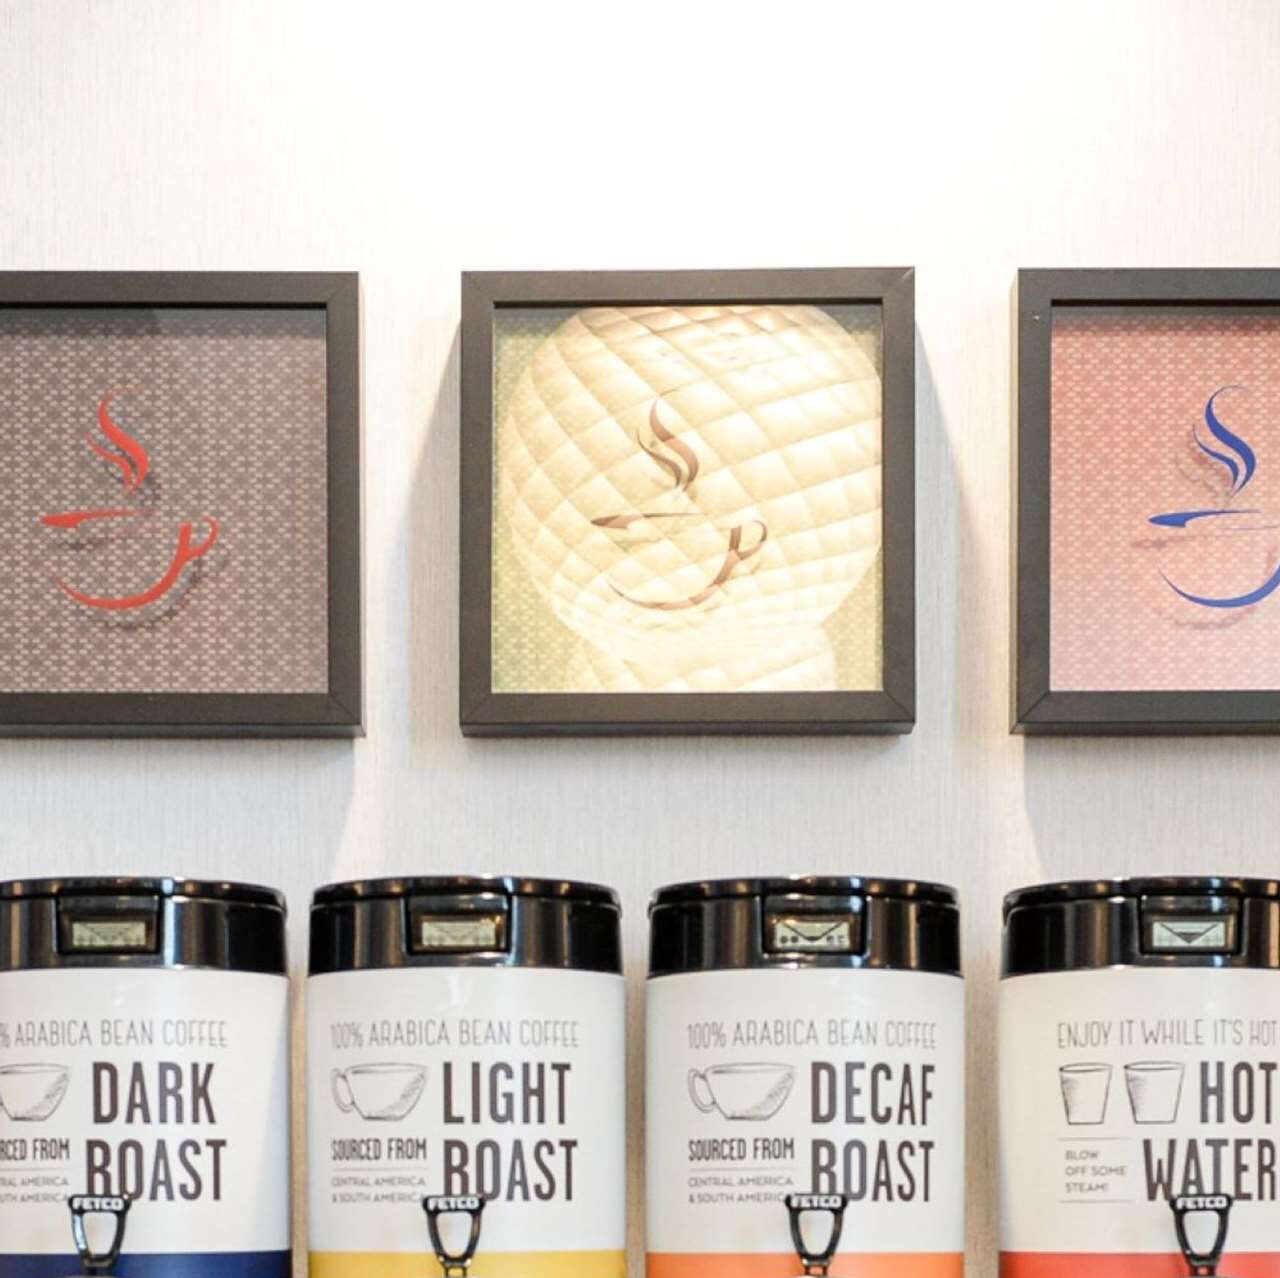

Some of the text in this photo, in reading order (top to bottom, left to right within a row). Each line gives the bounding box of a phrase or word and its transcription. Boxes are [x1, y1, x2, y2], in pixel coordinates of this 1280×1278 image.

[14, 1020, 92, 1047] ARABICA
[100, 1019, 153, 1046] BEAN
[162, 1020, 228, 1047] COFFEE
[331, 1019, 578, 1049] 100% ARABICA BEAN COFFEE
[688, 1019, 936, 1050] 100% ARABICA BEAN COFFEE
[1057, 1019, 1278, 1048] ENJOY IT WHILE IT'S HOT
[92, 1061, 216, 1124] DARK
[443, 1061, 571, 1124] LIGHT
[811, 1061, 935, 1125] DECAF
[1200, 1061, 1277, 1124] HOT
[32, 1138, 70, 1161] FROM
[331, 1138, 427, 1162] SOURCED FROM
[688, 1138, 795, 1162] SOURCED FROM
[1065, 1150, 1100, 1161] BLOW
[86, 1139, 227, 1201] ROAST
[444, 1139, 578, 1201] ROAST
[738, 1175, 794, 1187] AMERICA
[811, 1139, 935, 1202] ROAST
[1065, 1165, 1127, 1177] OFF SOME
[1143, 1138, 1276, 1201] WATER
[72, 1197, 124, 1210] FETCO
[738, 1192, 787, 1203] AMERIC
[1176, 1197, 1227, 1210] FETCO
